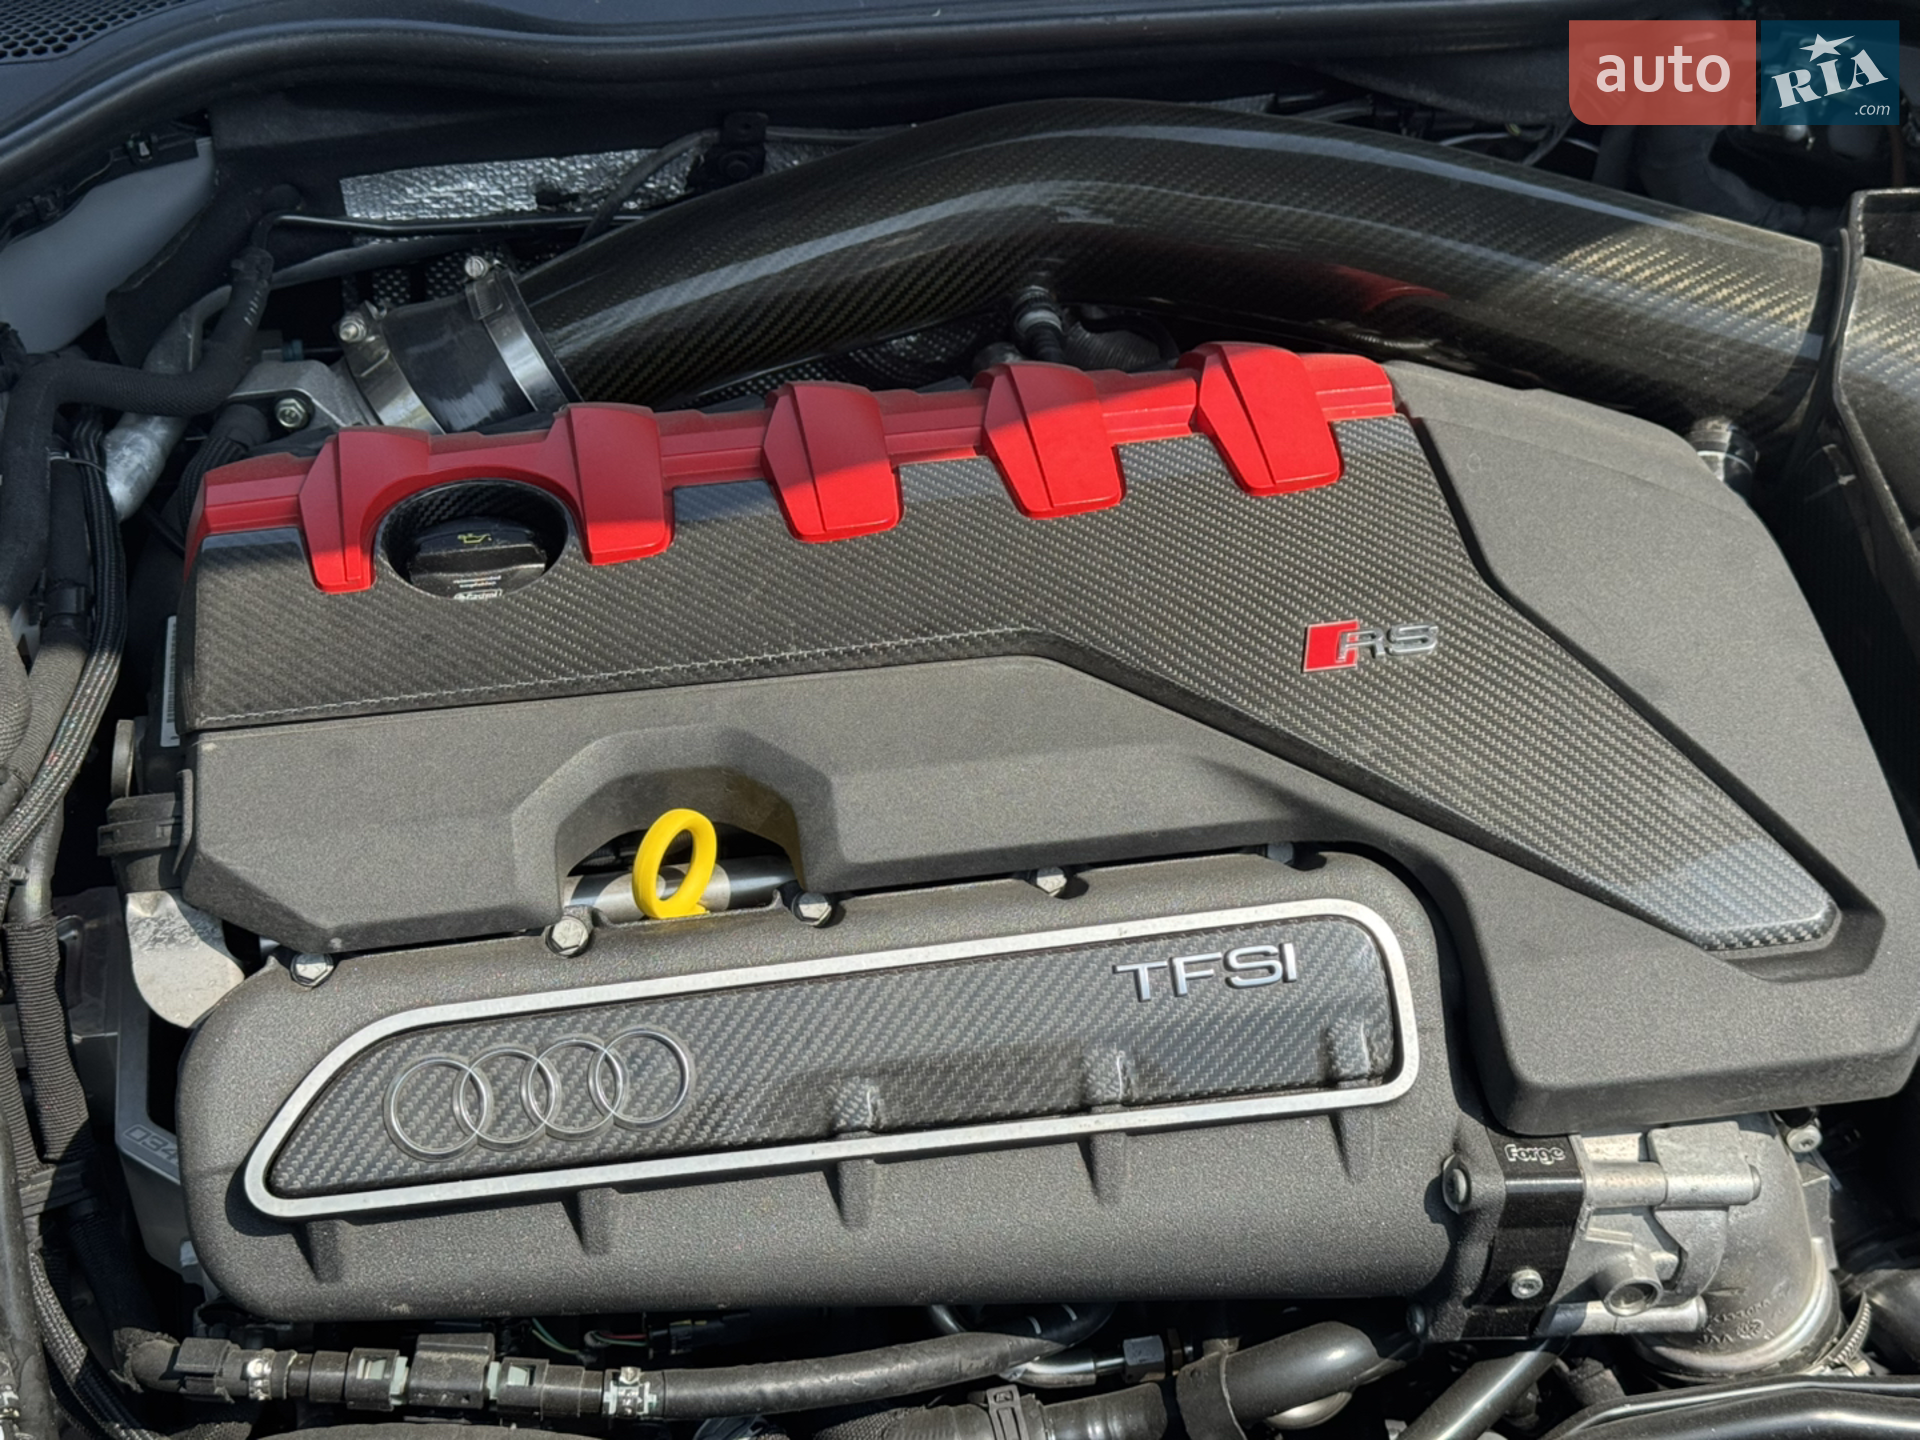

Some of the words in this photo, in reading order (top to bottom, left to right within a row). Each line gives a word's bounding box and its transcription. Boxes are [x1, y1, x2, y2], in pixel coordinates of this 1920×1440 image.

[1334, 623, 1439, 661] RS
[1112, 943, 1297, 1002] TFSI
[1504, 1143, 1566, 1165] Forge
